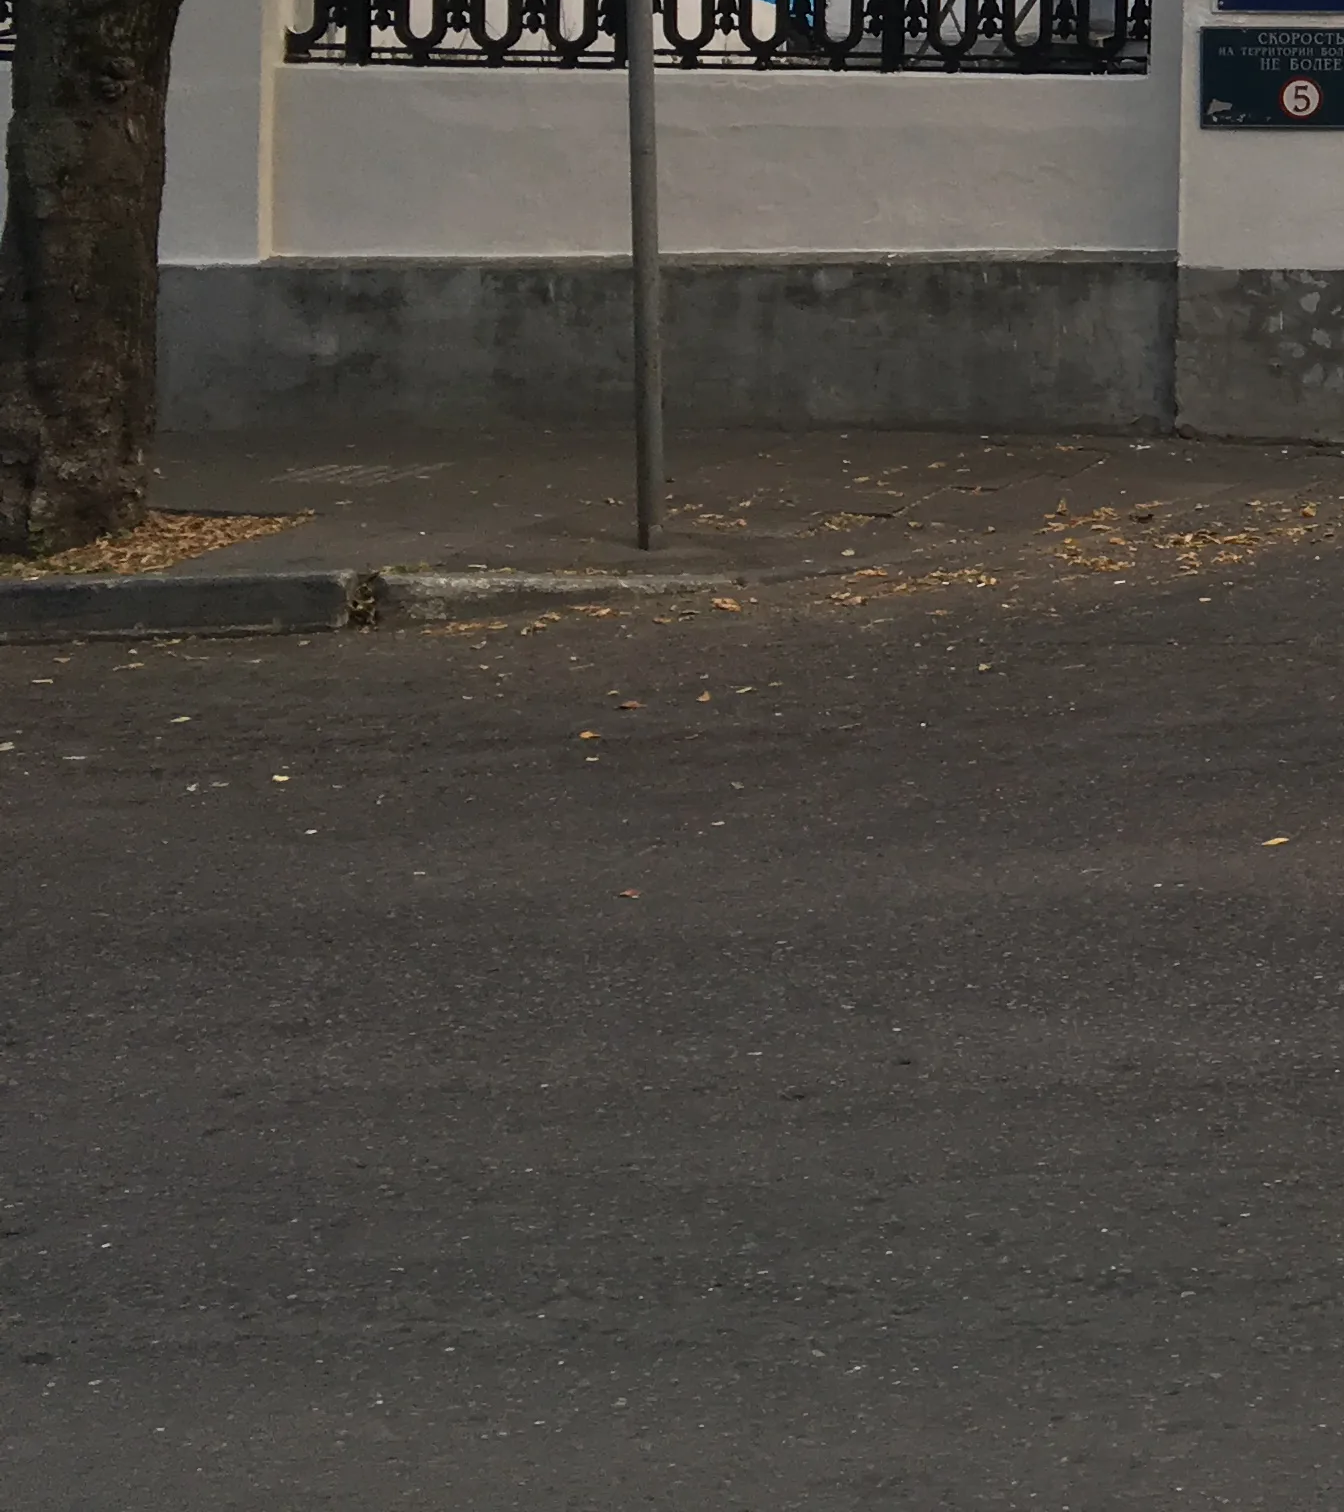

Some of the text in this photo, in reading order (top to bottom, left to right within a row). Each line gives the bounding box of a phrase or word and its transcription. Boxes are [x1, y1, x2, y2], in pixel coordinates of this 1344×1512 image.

[1258, 32, 1344, 45] СКОРОСТЬ
[1219, 47, 1234, 56] НА
[1241, 47, 1314, 57] ТЕРРИТОРИИ
[1260, 58, 1344, 71] НЕ БОЛЕЕ
[1293, 85, 1310, 113] 5
